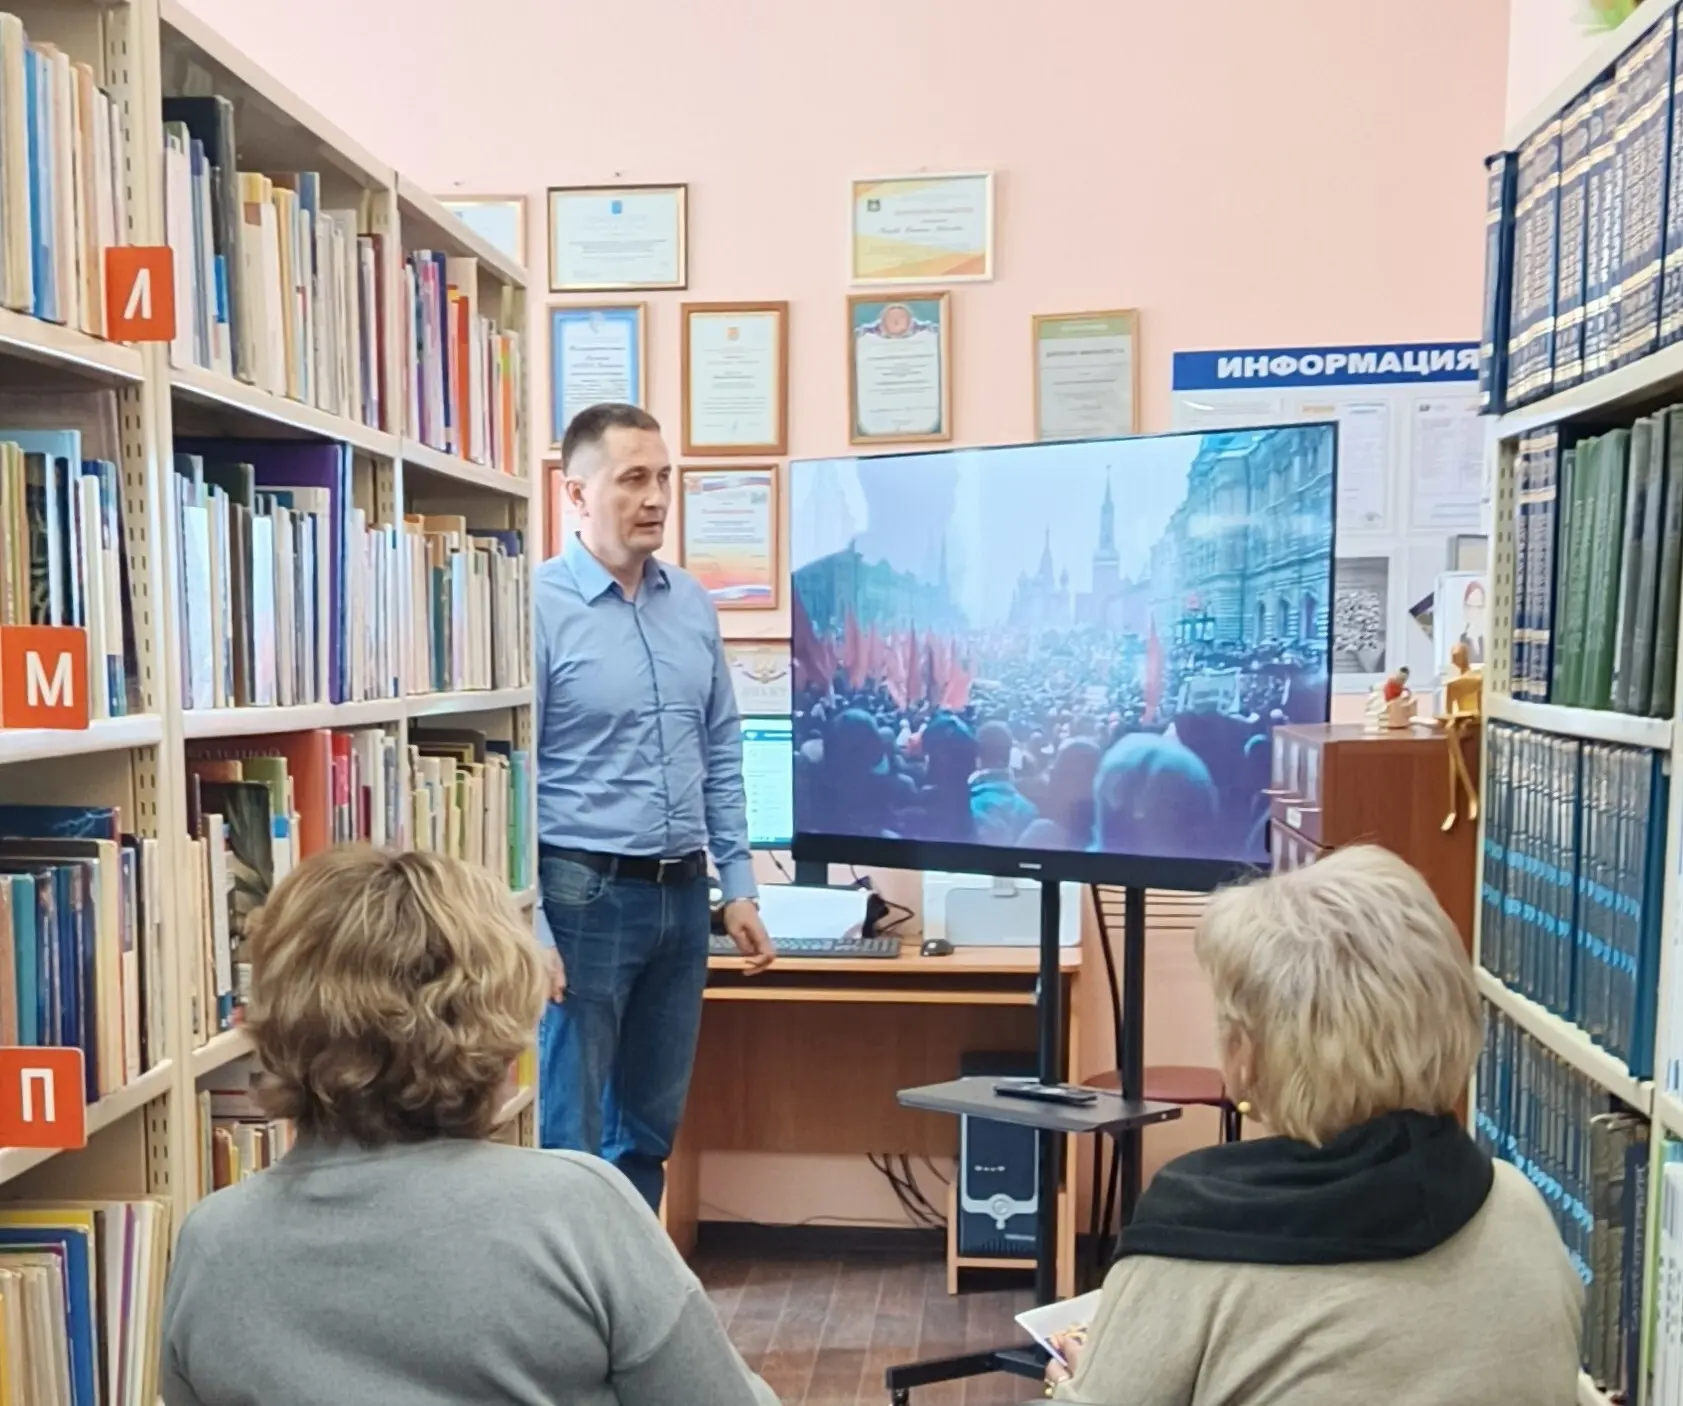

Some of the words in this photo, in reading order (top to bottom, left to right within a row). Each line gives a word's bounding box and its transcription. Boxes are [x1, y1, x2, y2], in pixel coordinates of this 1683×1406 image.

[122, 267, 153, 320] Л
[1217, 348, 1480, 379] ИНФОРМАЦИЯ
[25, 651, 74, 708] М
[21, 1068, 56, 1122] П
